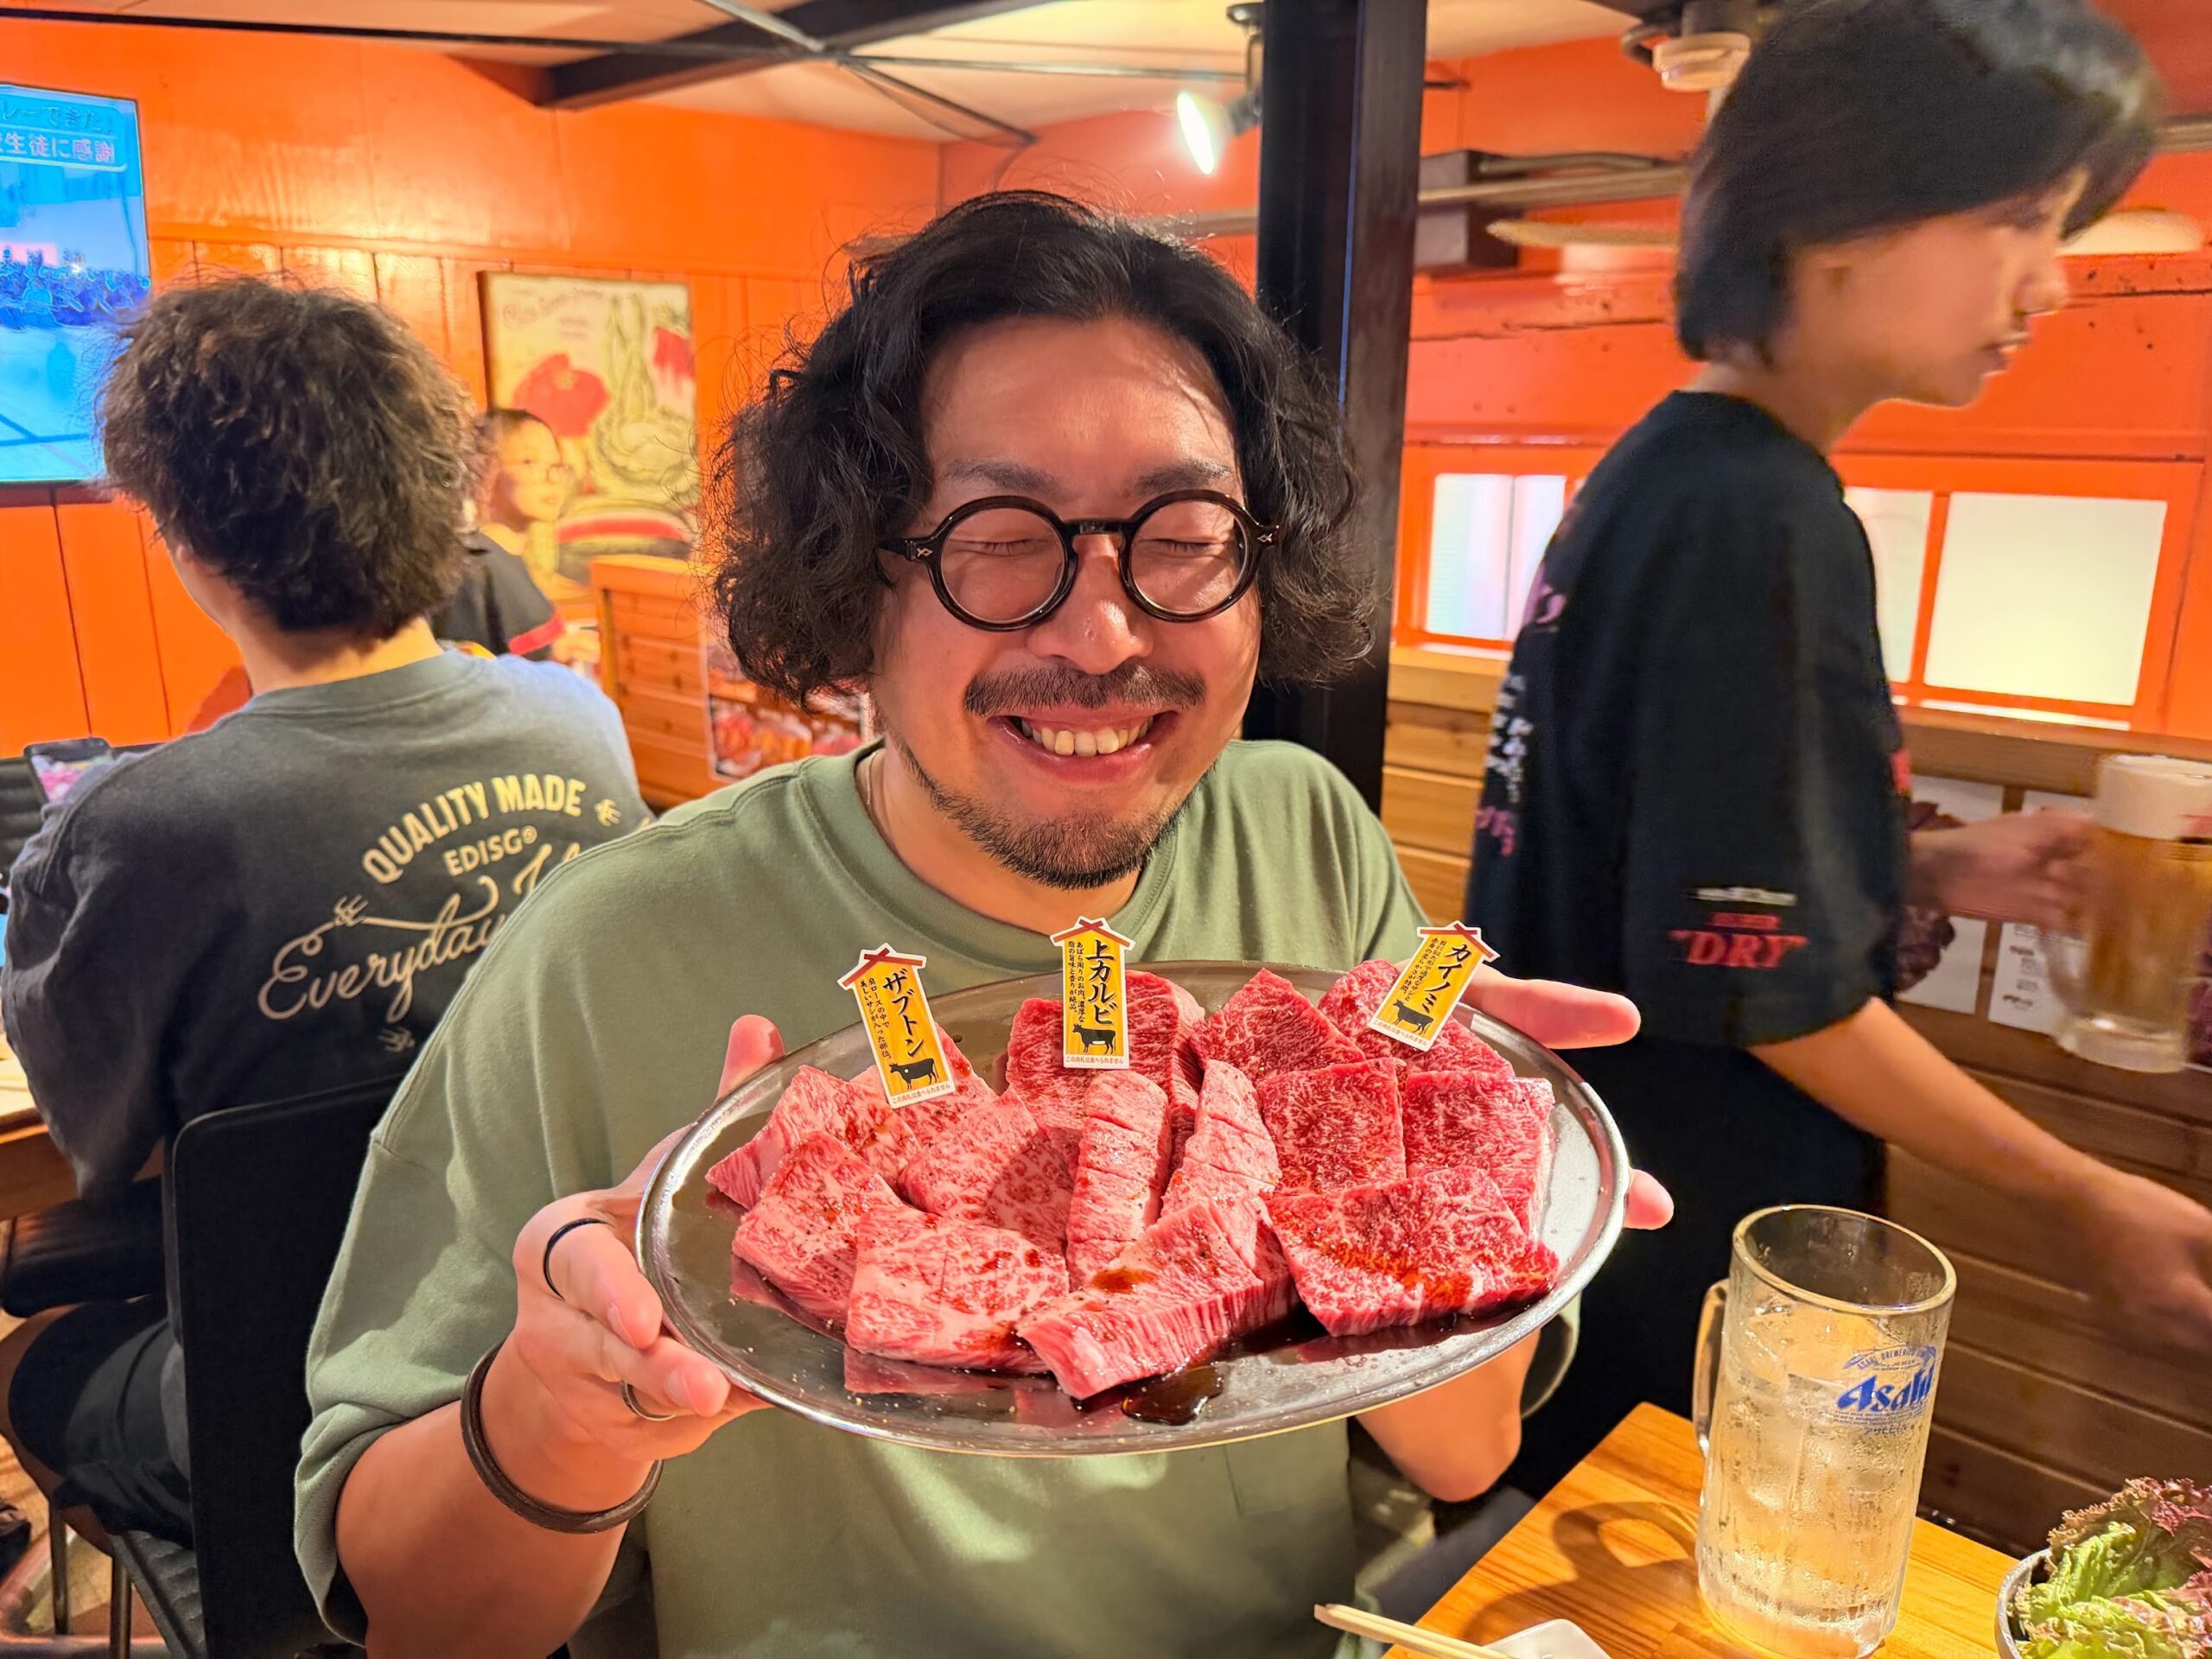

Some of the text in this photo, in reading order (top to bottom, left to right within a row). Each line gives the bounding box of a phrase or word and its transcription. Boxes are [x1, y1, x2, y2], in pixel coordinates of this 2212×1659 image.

[362, 781, 489, 884] QUALITY
[491, 773, 587, 817] MADE
[868, 977, 890, 1028] 肩ロースの中で
[882, 969, 924, 1057] ザブトン
[1085, 939, 1117, 1025] 上カルビ
[1422, 944, 1471, 1014] カイノミ
[1836, 1363, 1936, 1412] Asahi
